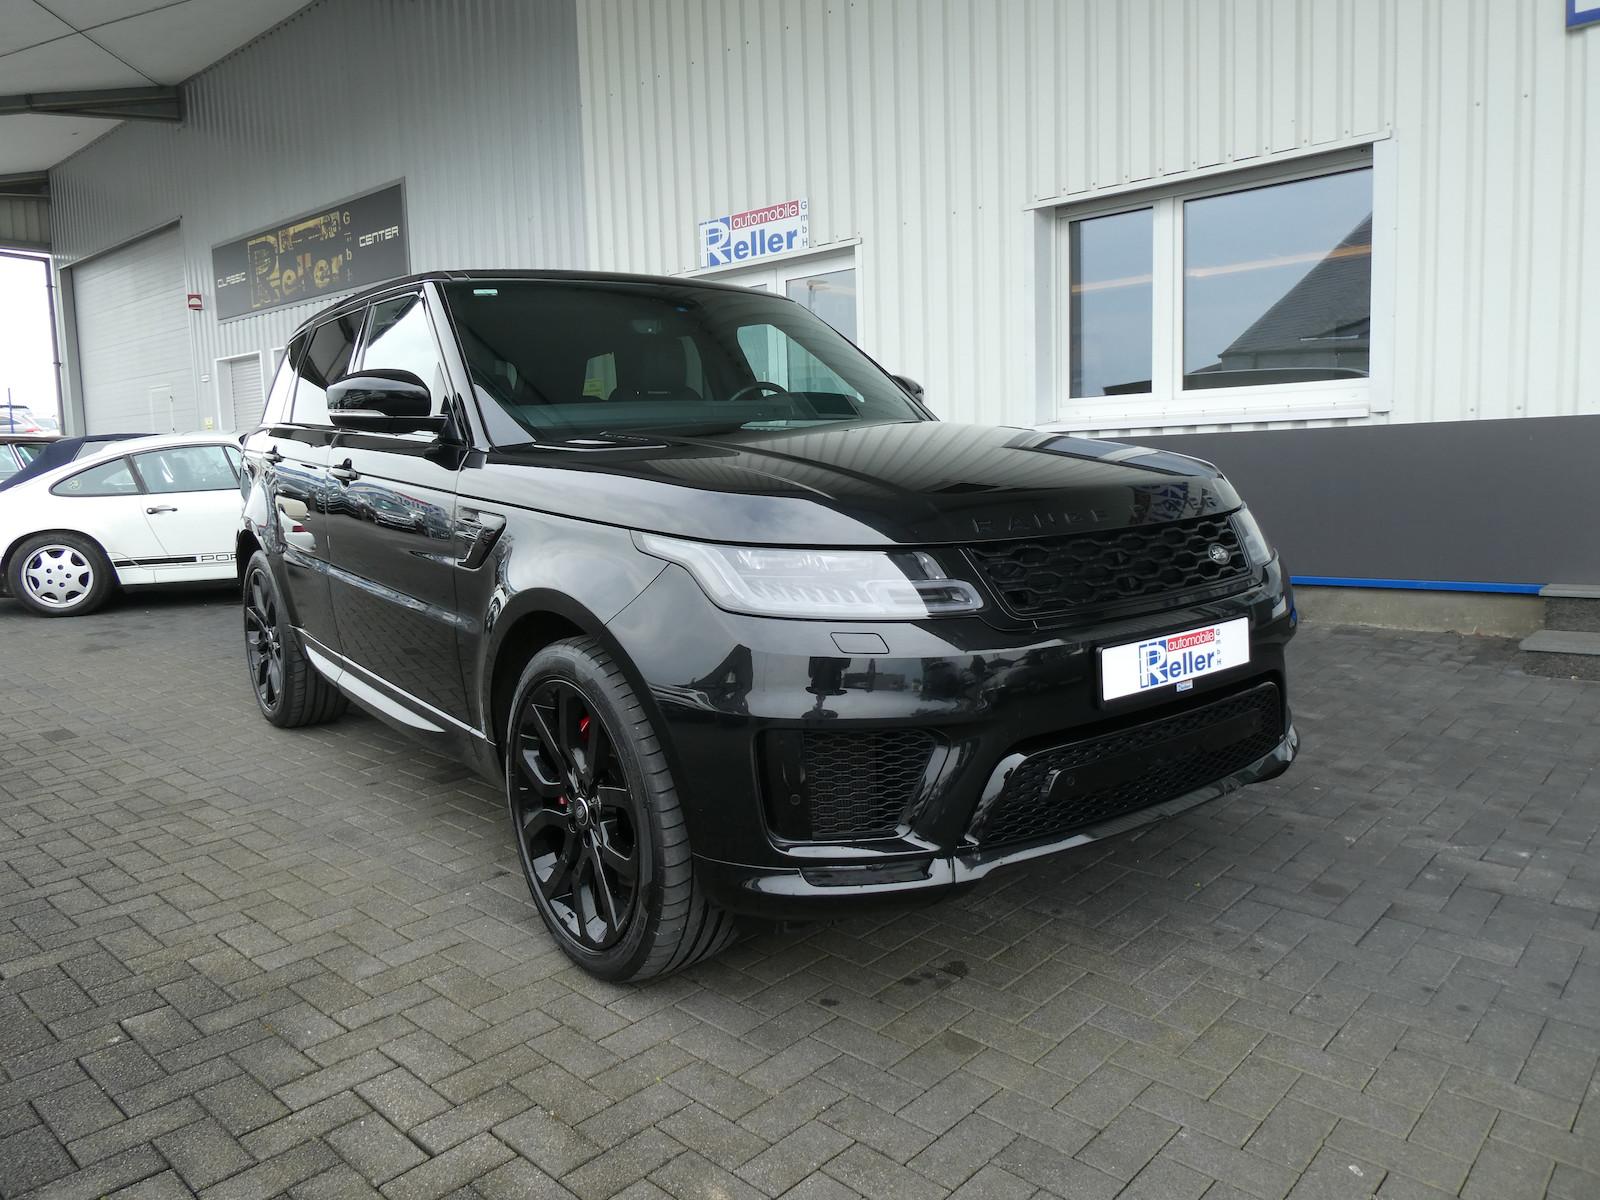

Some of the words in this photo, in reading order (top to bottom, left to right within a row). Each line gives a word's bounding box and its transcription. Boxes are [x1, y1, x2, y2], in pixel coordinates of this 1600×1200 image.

[732, 203, 798, 229] automobile
[800, 201, 809, 247] GmbH
[359, 225, 399, 247] CENTER
[699, 217, 798, 268] Reller
[1168, 630, 1215, 651] automobile
[1139, 640, 1215, 688] Reller
